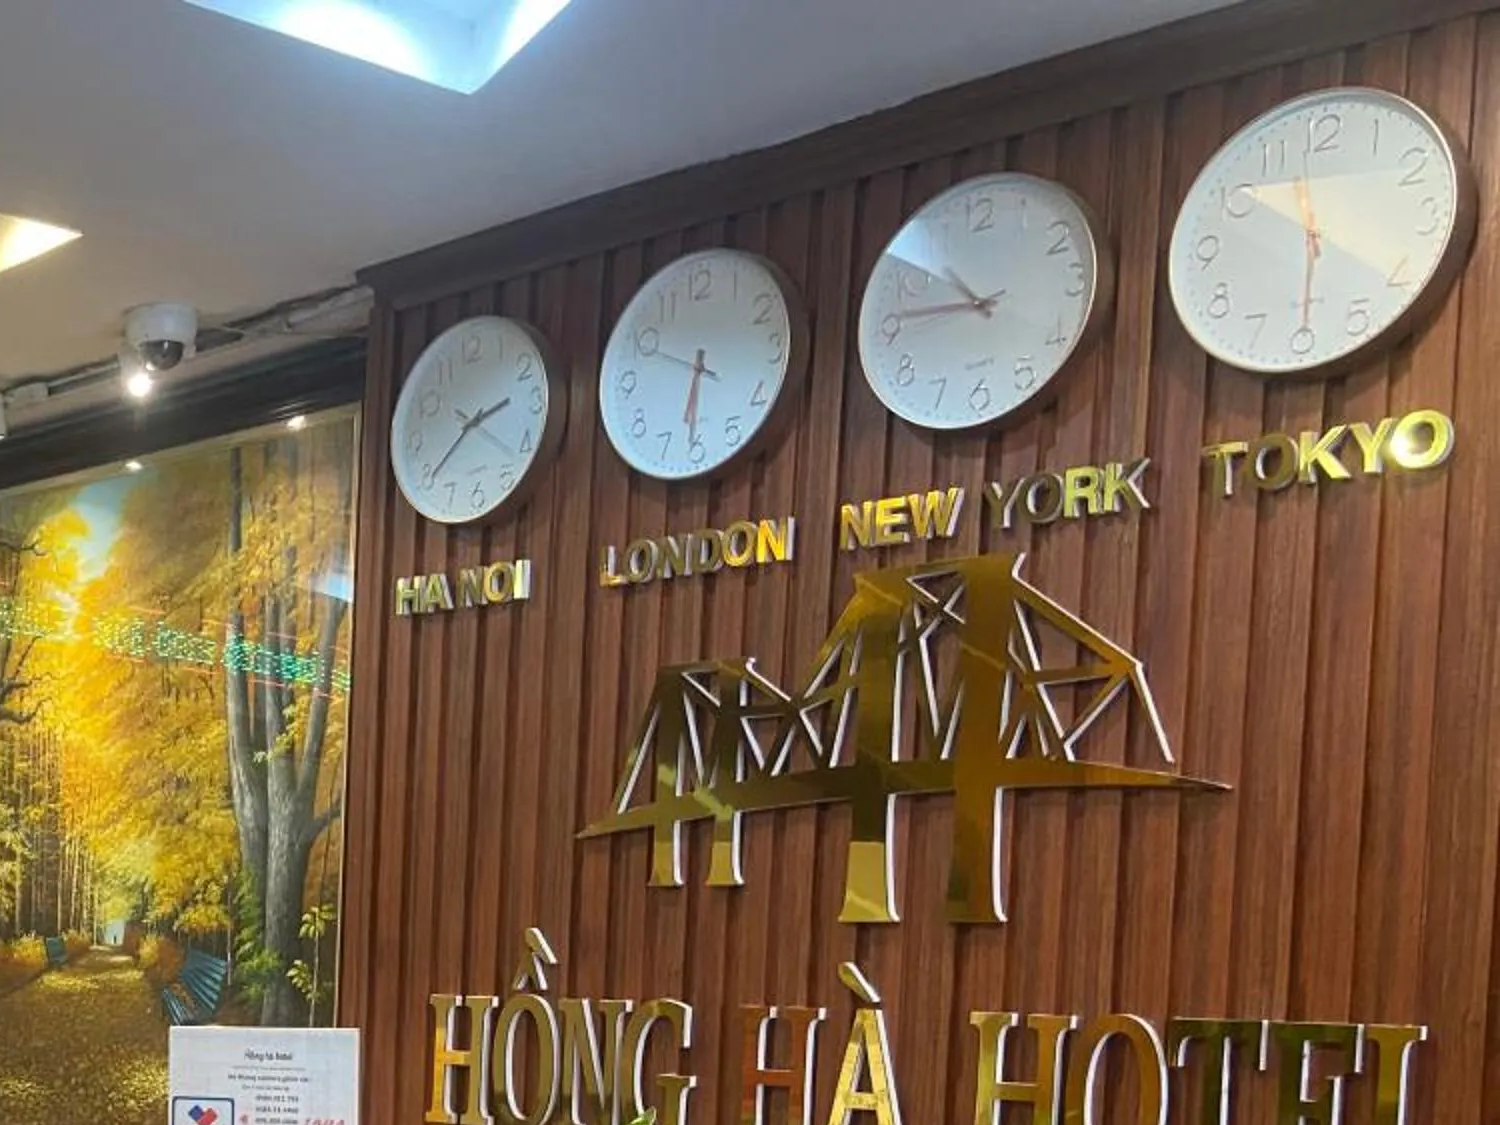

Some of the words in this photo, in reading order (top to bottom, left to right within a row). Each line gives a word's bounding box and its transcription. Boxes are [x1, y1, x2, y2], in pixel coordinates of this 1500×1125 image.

[1307, 114, 1342, 153] 12
[1373, 119, 1379, 156] 1
[1262, 140, 1286, 177] 11
[1398, 147, 1429, 187] 2
[966, 197, 995, 233] 12
[1220, 183, 1256, 219] 10
[1417, 197, 1441, 236] 3
[1046, 221, 1070, 255] 2
[1195, 235, 1220, 271] 9
[689, 270, 711, 301] 12
[1065, 262, 1085, 297] 3
[659, 291, 677, 323] 11
[754, 293, 773, 325] 2
[1207, 282, 1230, 319] 8
[1347, 298, 1370, 336] 5
[633, 327, 660, 361] 10
[881, 313, 902, 346] 9
[1245, 313, 1268, 350] 7
[462, 335, 482, 363] 12
[769, 333, 783, 364] 3
[516, 353, 532, 382] 2
[621, 371, 637, 398] 9
[897, 354, 915, 388] 8
[1014, 355, 1037, 391] 5
[530, 386, 542, 414] 3
[750, 380, 767, 406] 4
[930, 377, 947, 410] 7
[968, 379, 991, 411] 6
[631, 408, 647, 438] 8
[725, 416, 741, 447] 5
[520, 428, 532, 453] 4
[656, 431, 672, 461] 7
[690, 434, 706, 465] 6
[1201, 409, 1455, 498] TOKYO
[444, 482, 457, 505] 7
[471, 480, 485, 509] 6
[840, 487, 965, 551] NEW
[984, 457, 1151, 529] YORK
[600, 516, 796, 588] LONDON
[395, 576, 453, 616] HA
[457, 559, 532, 606] NOI
